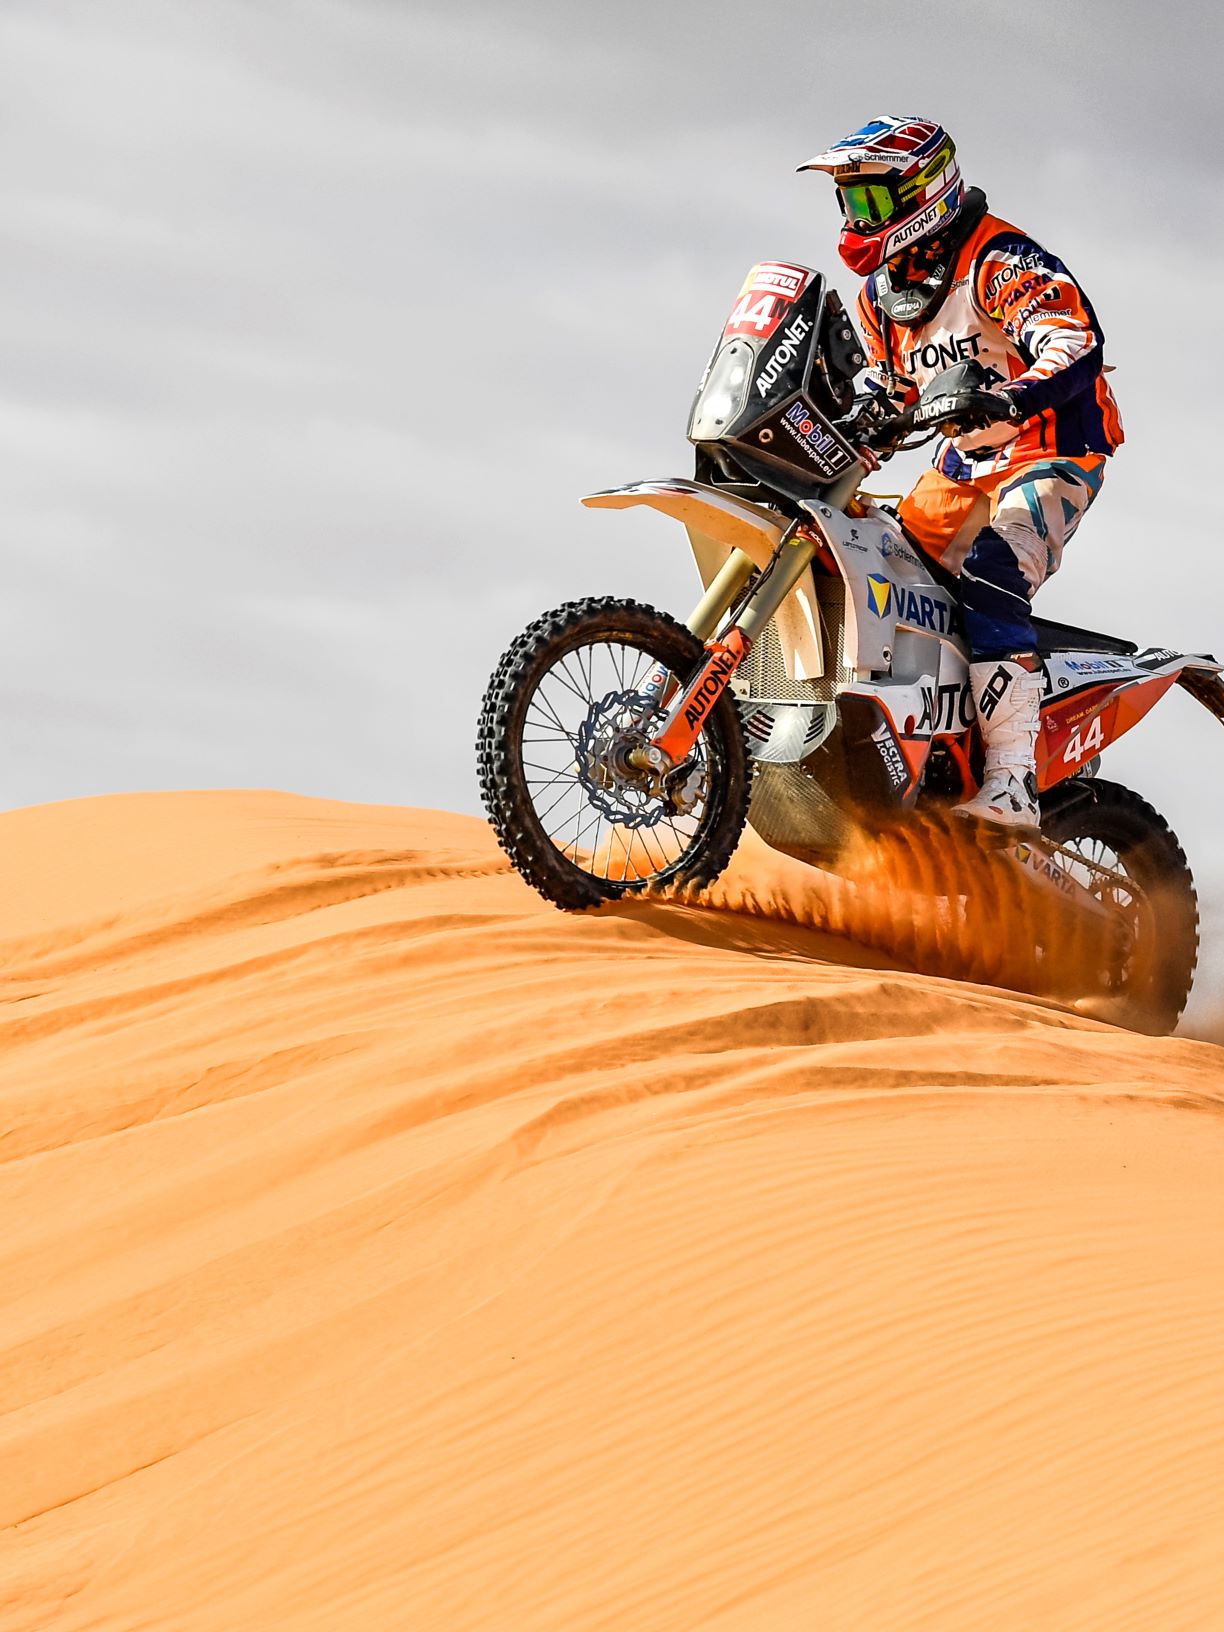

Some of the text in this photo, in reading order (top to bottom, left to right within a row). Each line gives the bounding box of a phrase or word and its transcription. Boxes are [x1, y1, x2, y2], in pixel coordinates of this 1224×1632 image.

[864, 153, 909, 163] Schlemmer
[893, 206, 938, 247] AUTONET
[984, 253, 1041, 301] UTONET
[727, 293, 776, 331] 44
[786, 401, 835, 453] Mobil
[913, 397, 959, 425] AUTONET
[684, 647, 738, 731] AUTONET
[871, 722, 908, 783] VECTRA
[1063, 716, 1104, 764] 44
[876, 742, 901, 788] LOGISTIC
